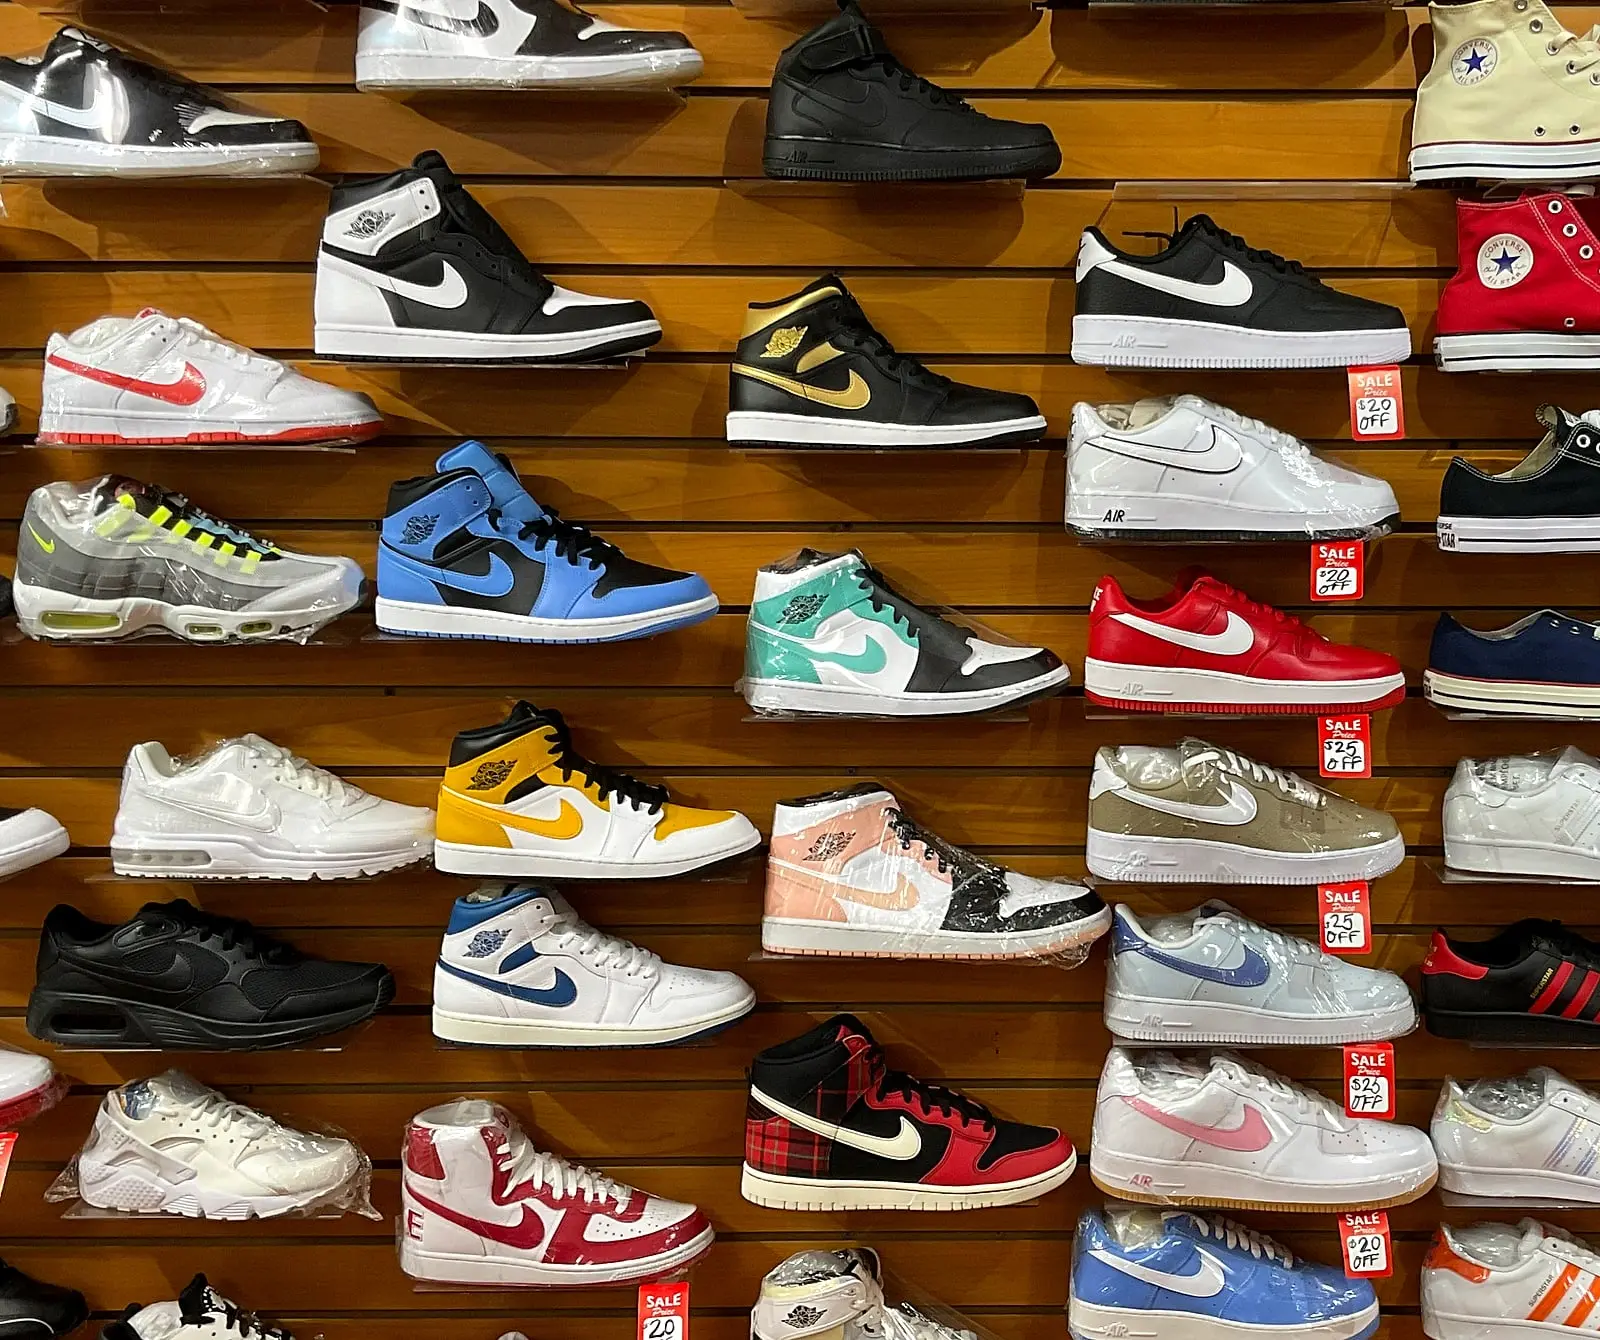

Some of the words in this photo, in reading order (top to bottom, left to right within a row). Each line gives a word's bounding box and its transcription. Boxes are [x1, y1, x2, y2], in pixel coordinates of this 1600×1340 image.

[1455, 41, 1493, 60] CONVERSE
[1485, 240, 1526, 258] CONVERSE
[1112, 334, 1137, 349] AIR
[1357, 373, 1393, 388] SALE
[1364, 387, 1389, 398] Price
[1358, 398, 1392, 412] $20
[1360, 412, 1390, 430] OFF
[1102, 509, 1125, 522] AIR
[1441, 532, 1456, 548] STAR
[1319, 545, 1356, 560] SALE
[1325, 558, 1350, 568] Price
[1319, 569, 1350, 582] $20
[1319, 580, 1353, 594] OFF
[1121, 682, 1144, 696] AIR
[1325, 719, 1362, 731] SALE
[1332, 730, 1357, 739] Price
[1327, 756, 1363, 770] OFF
[1325, 889, 1361, 903] SALE
[1327, 930, 1361, 943] OFF
[1141, 1014, 1164, 1028] AIR
[1351, 1052, 1386, 1066] SALE
[1351, 1077, 1381, 1095] $25
[1351, 1094, 1383, 1111] OFF
[1128, 1173, 1153, 1188] AIR
[1345, 1211, 1381, 1226] SALE
[1349, 1236, 1381, 1253] $20
[1353, 1253, 1380, 1269] OFF
[1528, 1274, 1554, 1307] SUPERSTAR
[646, 1292, 682, 1308] SALE
[1105, 1322, 1129, 1337] AIR
